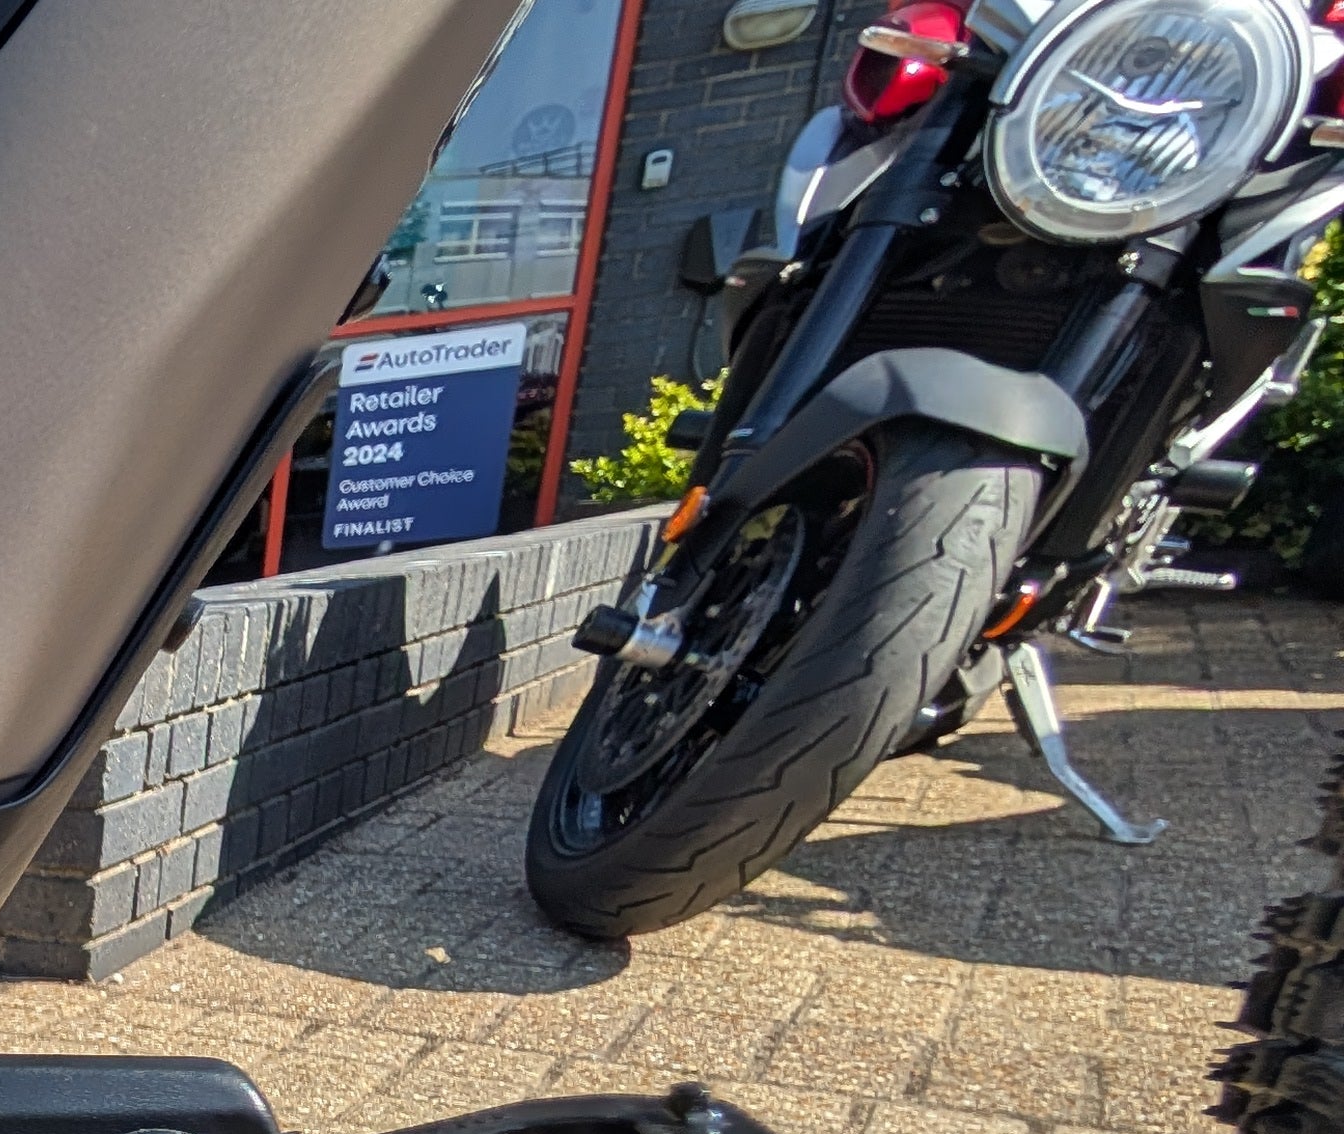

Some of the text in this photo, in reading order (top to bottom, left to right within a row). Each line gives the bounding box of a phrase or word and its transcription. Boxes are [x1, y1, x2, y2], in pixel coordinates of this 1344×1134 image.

[377, 337, 512, 370] AutoTrader
[349, 385, 445, 414] Retailer
[345, 411, 437, 440] Awards
[342, 441, 404, 467] 2024
[339, 468, 475, 495] Customer Choice
[336, 493, 390, 512] Award
[333, 517, 415, 538] FINALIST
